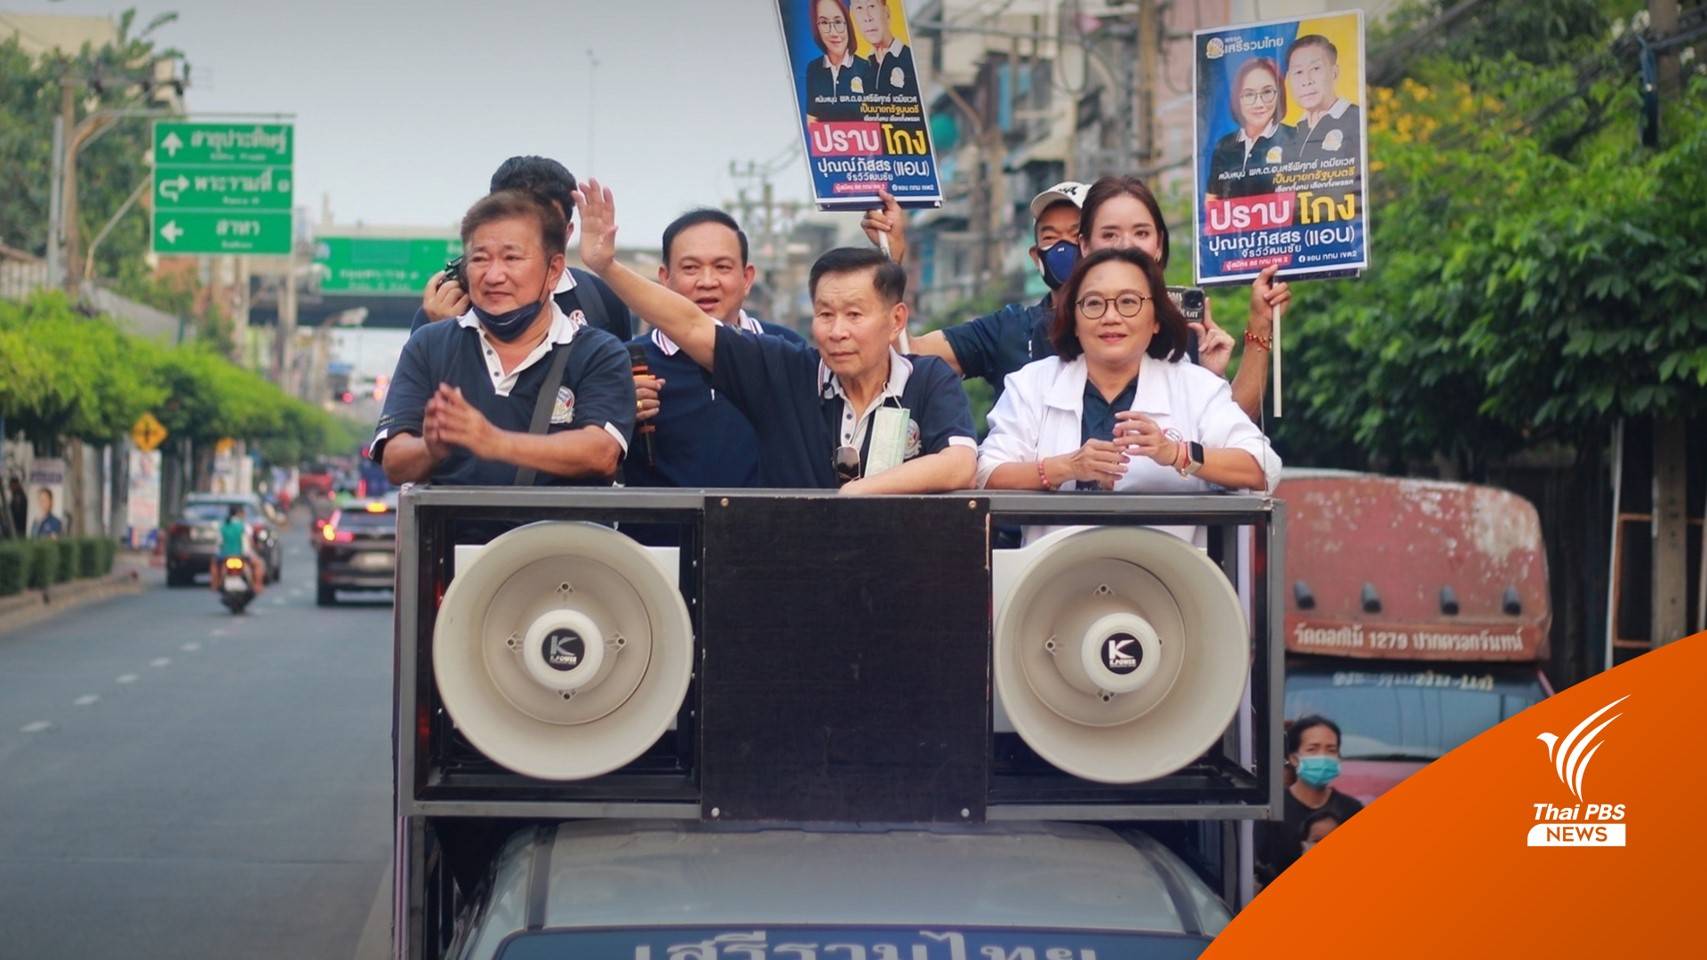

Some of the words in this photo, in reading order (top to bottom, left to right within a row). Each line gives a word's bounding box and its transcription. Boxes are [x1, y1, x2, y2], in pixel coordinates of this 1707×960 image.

[813, 124, 880, 152] ปราบ
[881, 123, 927, 155] โกง
[893, 160, 929, 177] (แอน)
[1210, 200, 1290, 231] ปราบ
[1297, 191, 1355, 225] โกง
[1304, 225, 1355, 248] (แอน)
[1369, 632, 1408, 649] 1279
